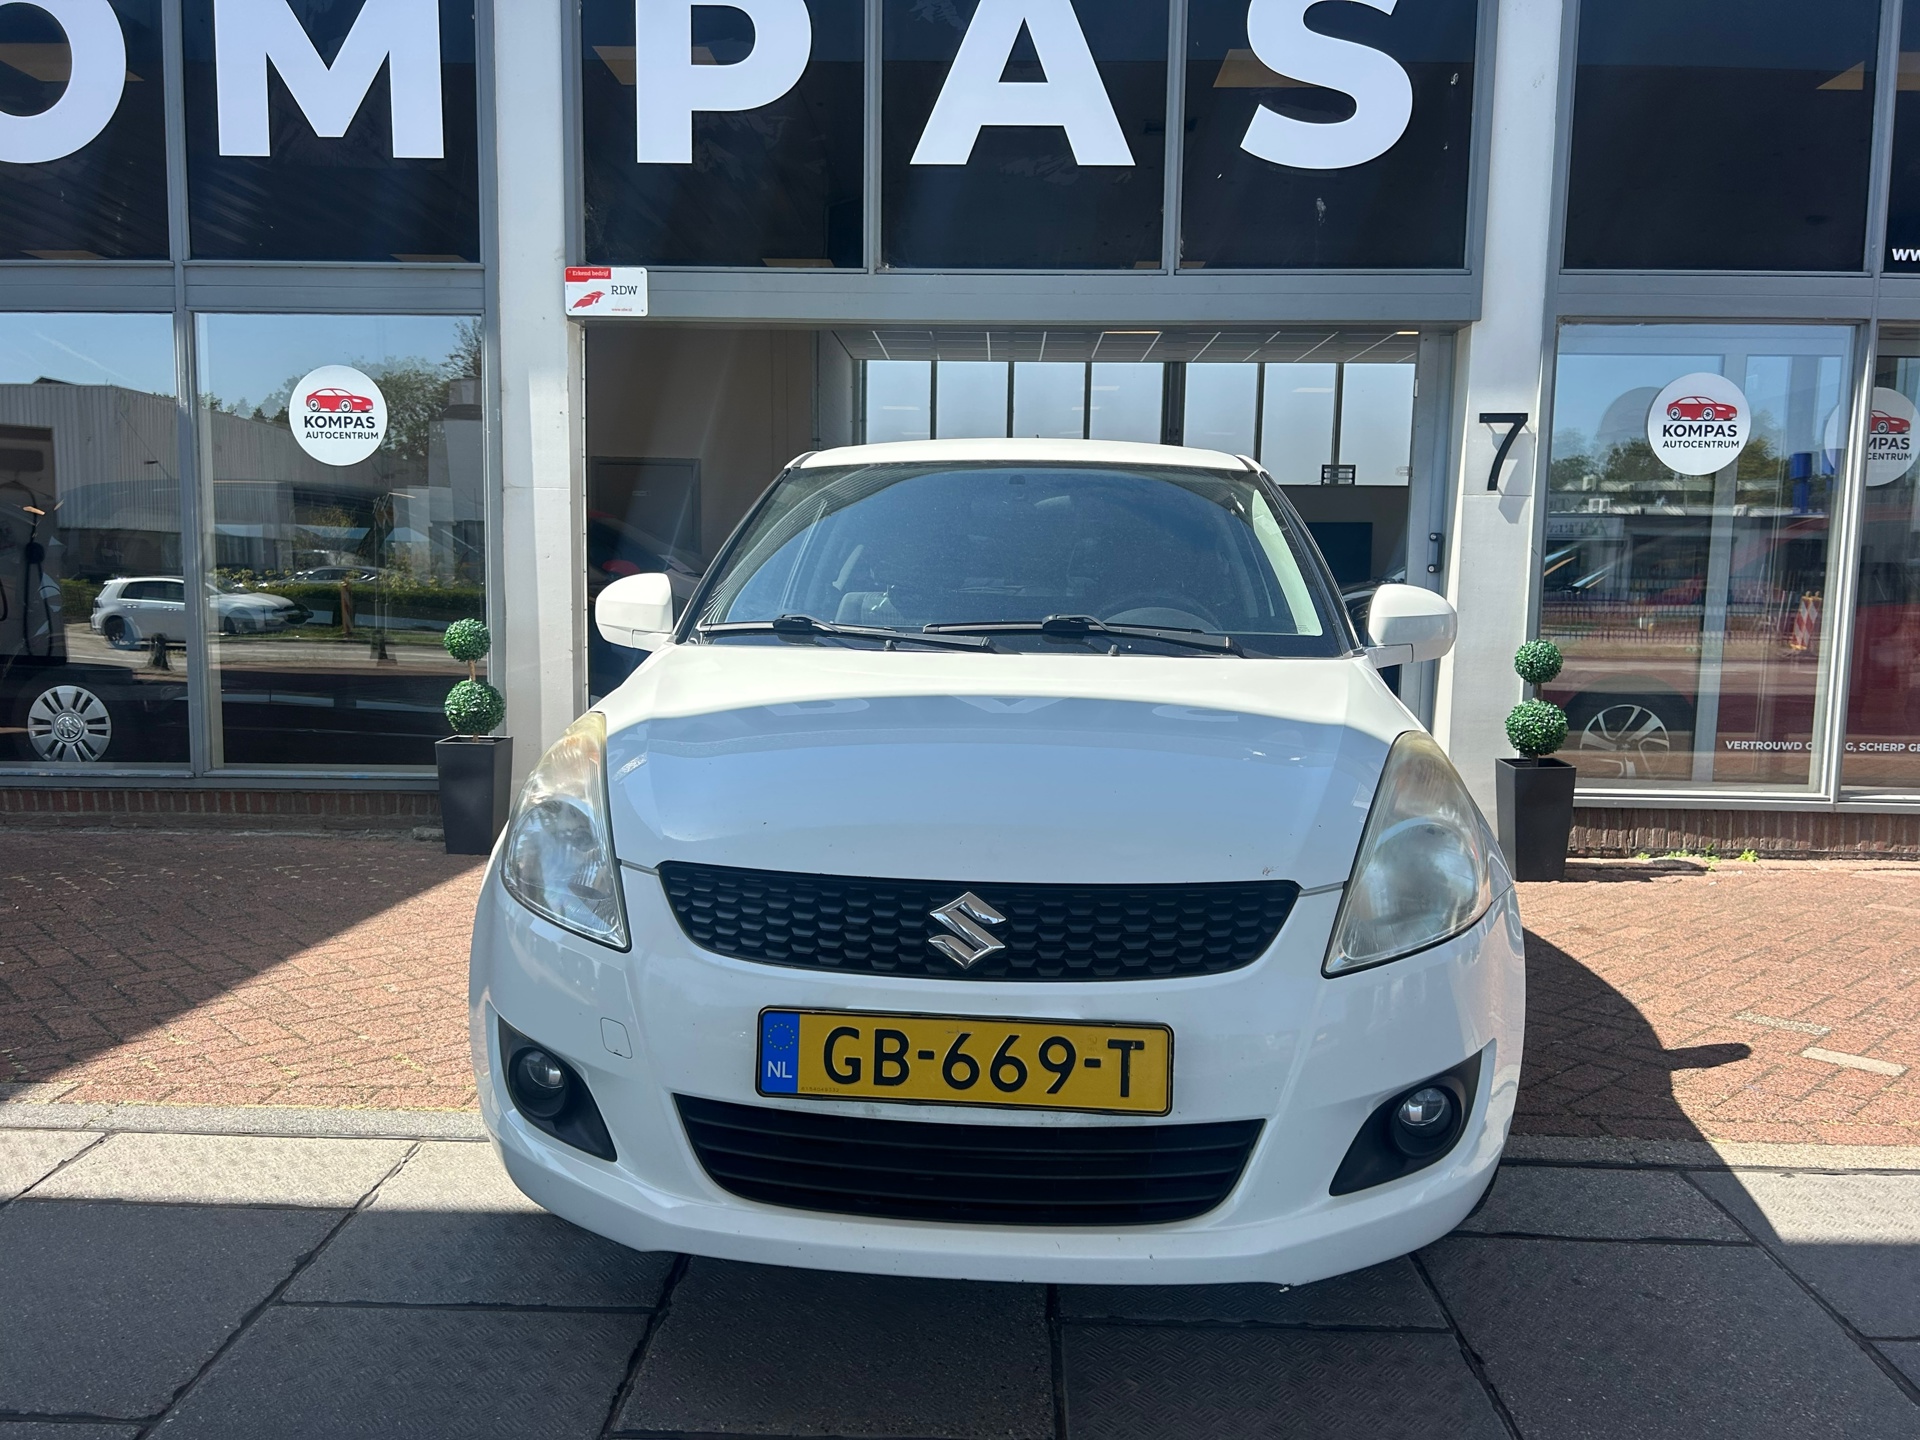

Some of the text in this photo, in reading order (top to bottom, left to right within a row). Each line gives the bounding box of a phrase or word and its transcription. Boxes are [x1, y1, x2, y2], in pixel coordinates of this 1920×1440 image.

[611, 285, 638, 295] RDW
[304, 415, 376, 428] KOMPAS
[305, 431, 379, 439] AUTOCENTRUM
[1662, 424, 1737, 437] KOMPAS
[1662, 440, 1740, 448] AUTOCENTRUM
[1868, 437, 1910, 450] MPAS
[1479, 412, 1528, 491] 7
[1868, 452, 1912, 460] CENTRUM
[1725, 740, 1802, 751] VERTROUWD
[1859, 742, 1906, 752] SCHERP
[823, 1026, 1145, 1098] GB-669-T
[767, 1060, 793, 1079] NL
